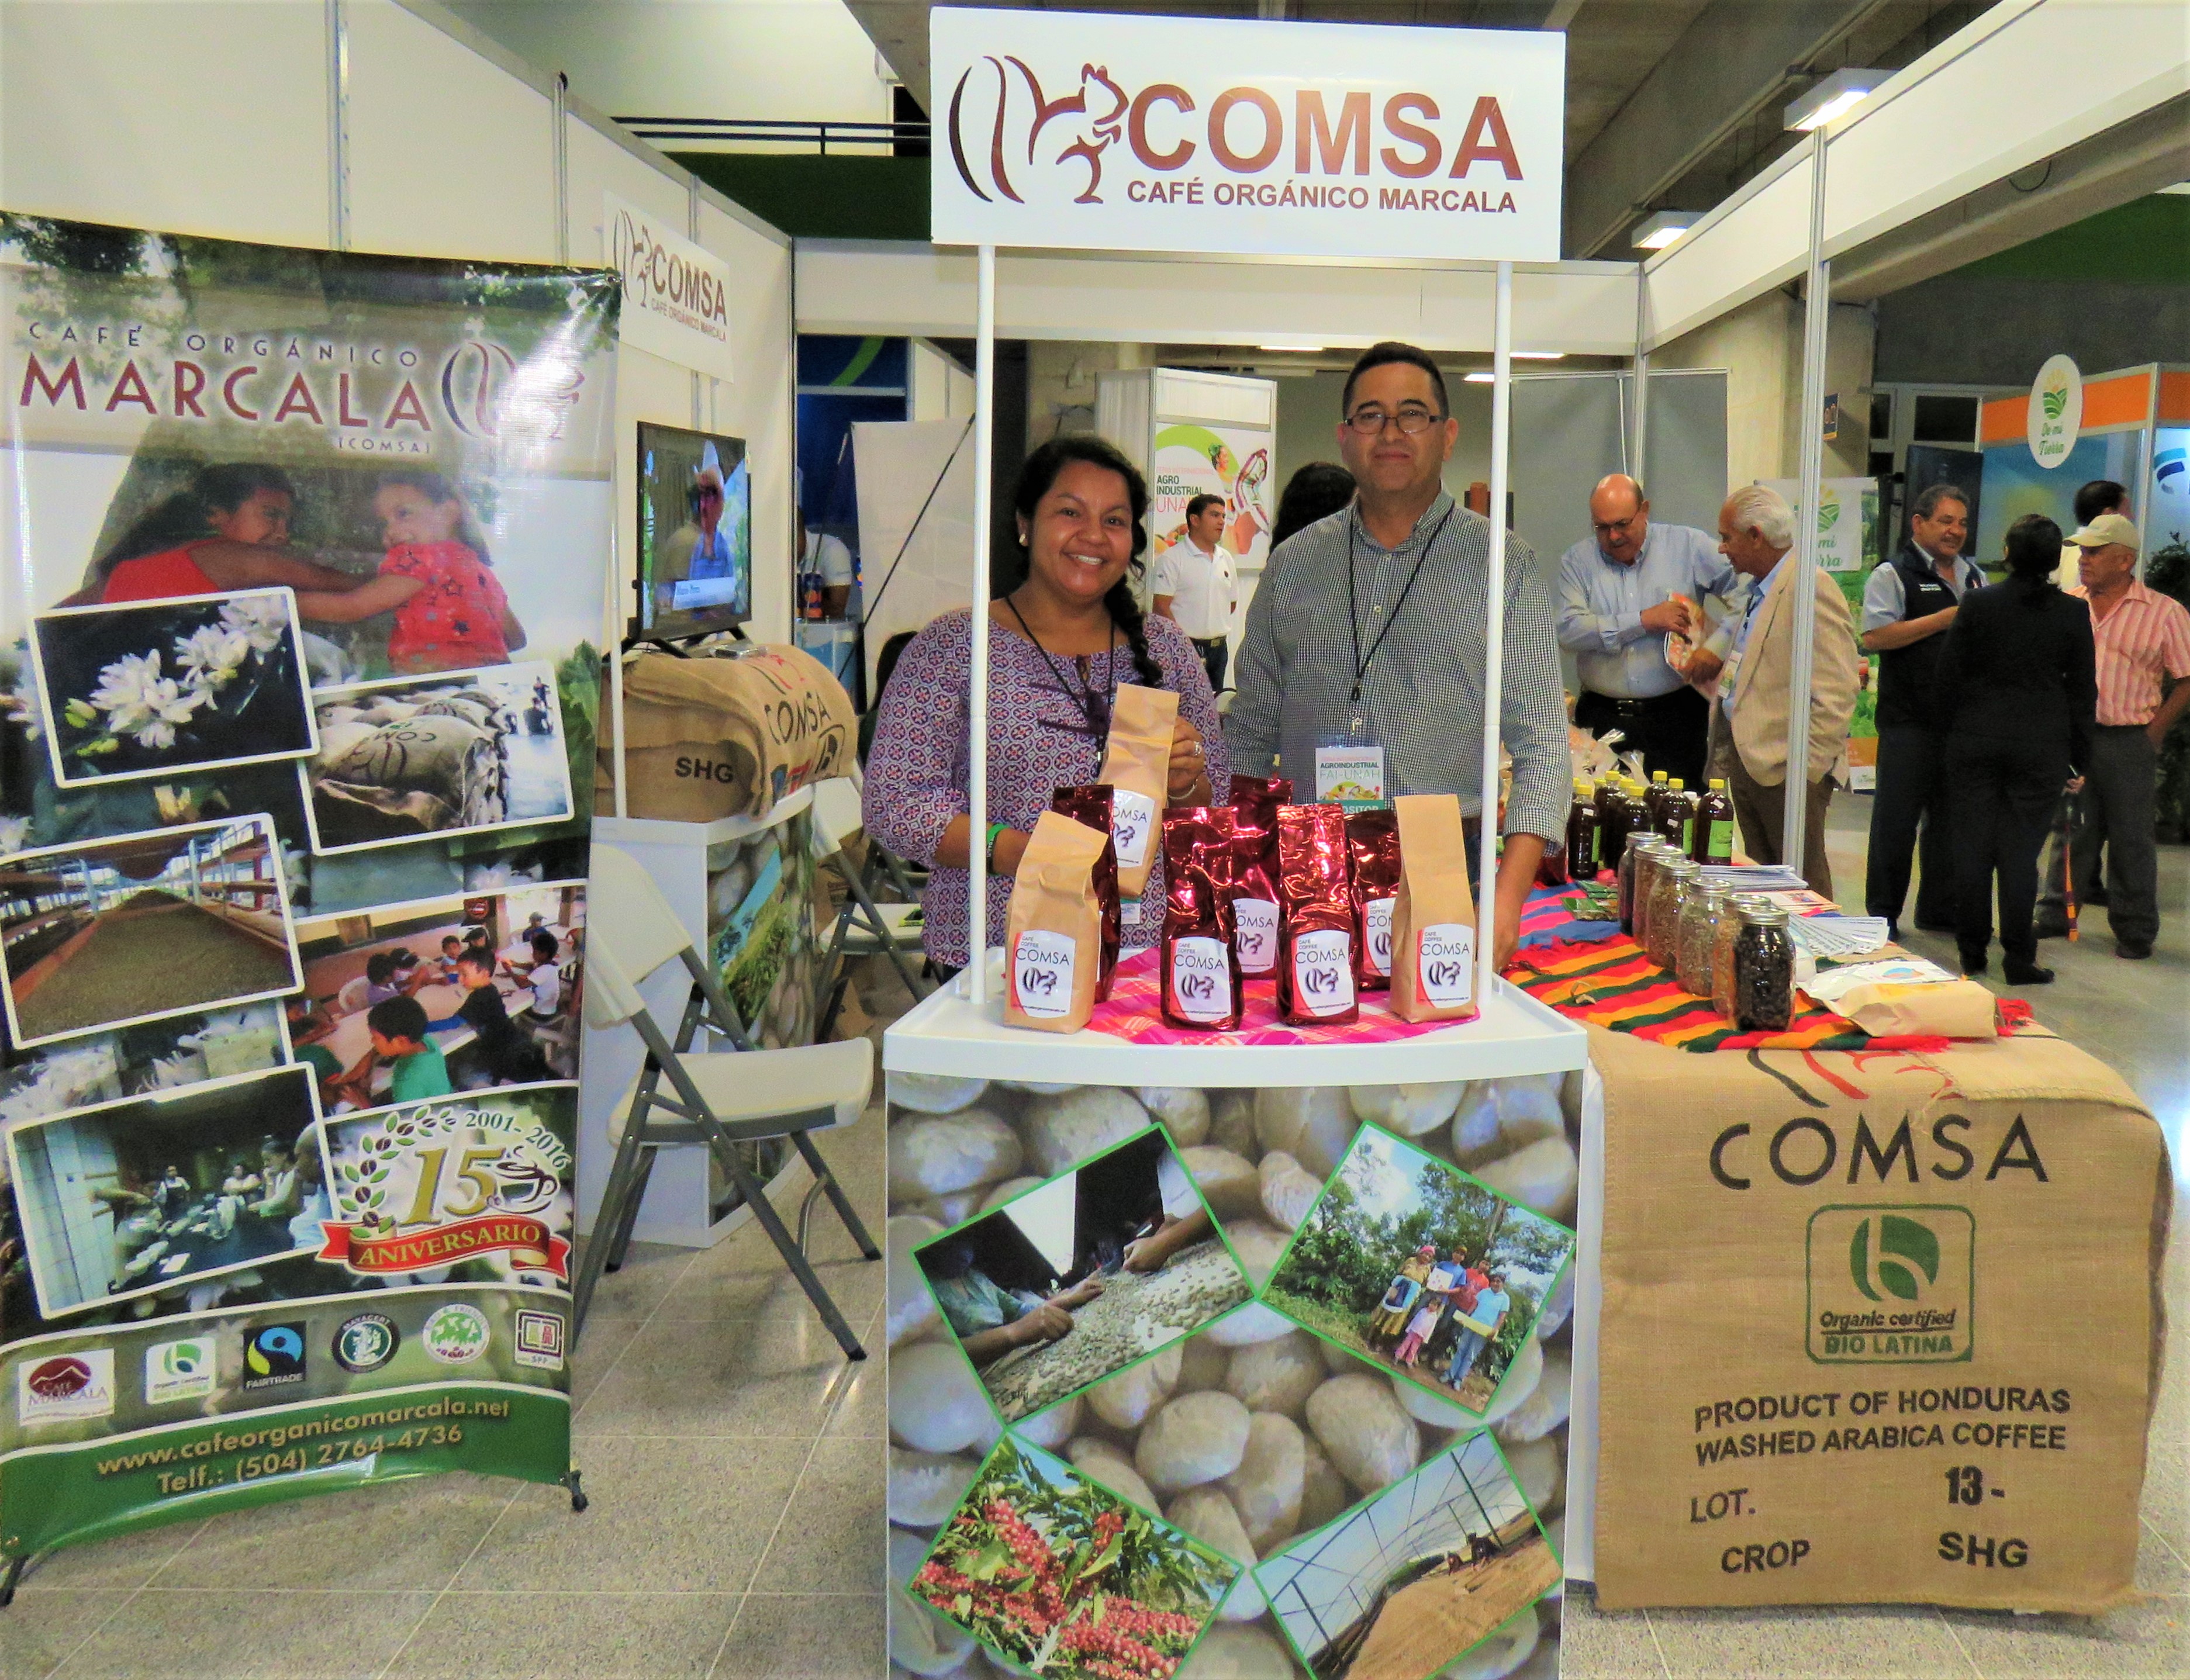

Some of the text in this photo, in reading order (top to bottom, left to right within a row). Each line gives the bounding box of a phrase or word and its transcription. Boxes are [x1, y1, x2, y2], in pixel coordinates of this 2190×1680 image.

[1128, 84, 1524, 181] COMSA
[1127, 177, 1517, 214] CAFÉ ORGÁNICO MARCALA
[652, 244, 727, 326] COMSA
[29, 322, 417, 368] CAFÉ ORGÁNICO
[20, 354, 431, 431] MARCALA
[1157, 475, 1180, 485] AGRO
[1156, 496, 1191, 513] UNA
[1818, 535, 1836, 548] mi
[764, 691, 831, 745] COMSA
[675, 756, 734, 784] SHG
[1113, 806, 1147, 823] OMSA
[1343, 806, 1379, 814] OSITOR
[1236, 915, 1274, 928] OMSA
[1015, 948, 1069, 966] COMSA
[1174, 955, 1225, 970] COMSA
[1295, 948, 1346, 963] COMSA
[1420, 943, 1470, 956] COMSA
[466, 1113, 572, 1169] 2001- 2016
[1709, 1113, 2050, 1190] COMSA
[399, 1148, 506, 1226] 15
[357, 1225, 540, 1266] ANIVERSARIO
[1819, 1309, 1956, 1329] Organic certified
[1825, 1334, 1953, 1354] BIO LATINA
[246, 1374, 303, 1388] FAIRTRADE
[1694, 1387, 2071, 1433] PRODUCT OF HONDURAS
[97, 1396, 509, 1475] www.cafeorganicomarcala.net
[236, 1447, 306, 1482] (504)
[318, 1424, 462, 1463] 2764-4736
[1695, 1422, 2067, 1467] WASHED ARABICA COFFEE
[1690, 1488, 1756, 1524] LOT.
[1721, 1539, 1811, 1574] CROP
[1937, 1531, 2029, 1568] SHG
